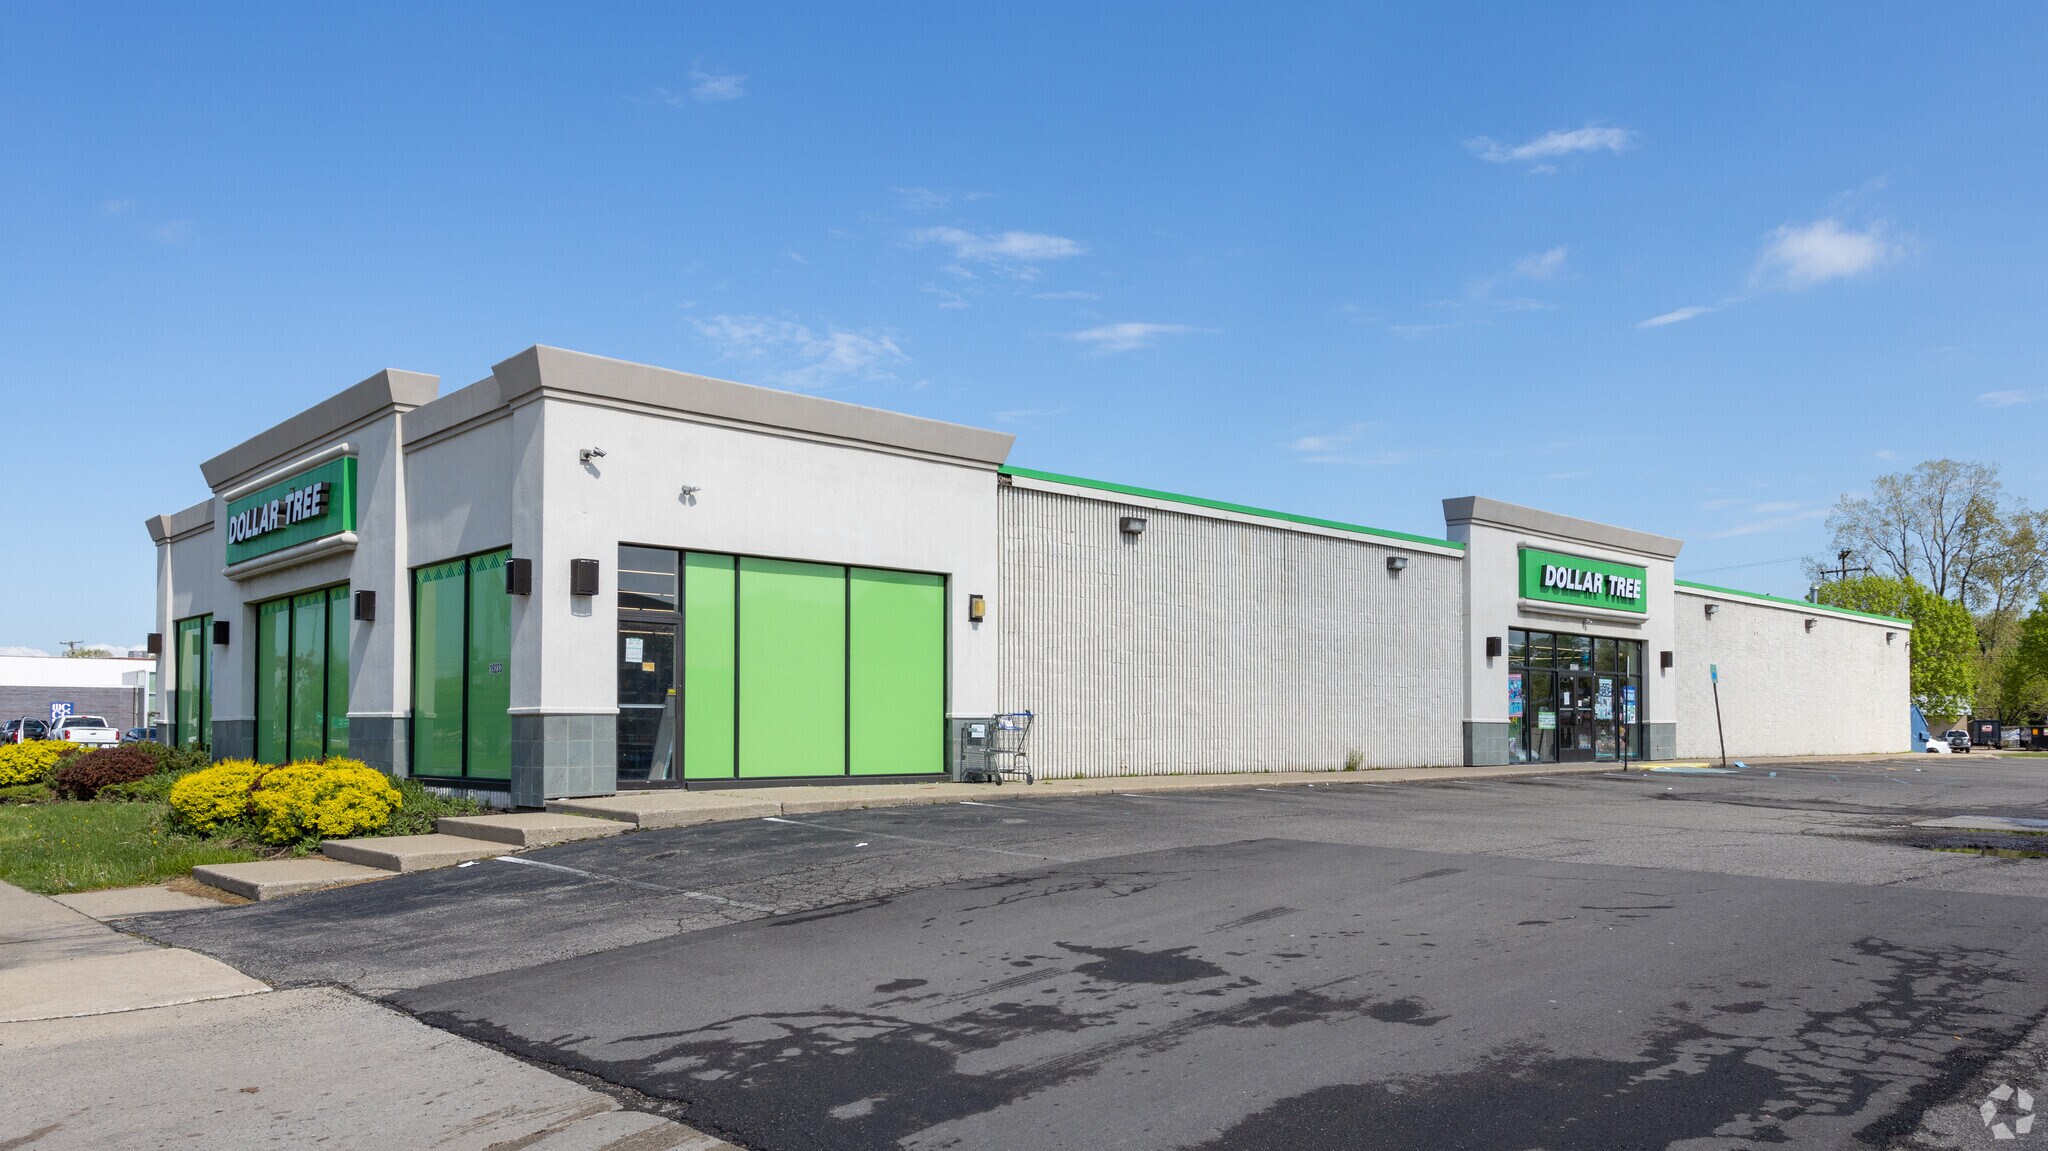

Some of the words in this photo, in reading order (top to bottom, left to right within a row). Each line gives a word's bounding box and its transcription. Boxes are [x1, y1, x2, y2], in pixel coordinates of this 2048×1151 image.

[228, 499, 281, 545] DOLLAR
[285, 482, 323, 525] TREE
[1544, 564, 1603, 593] DOLLAR
[1608, 574, 1641, 599] TREE
